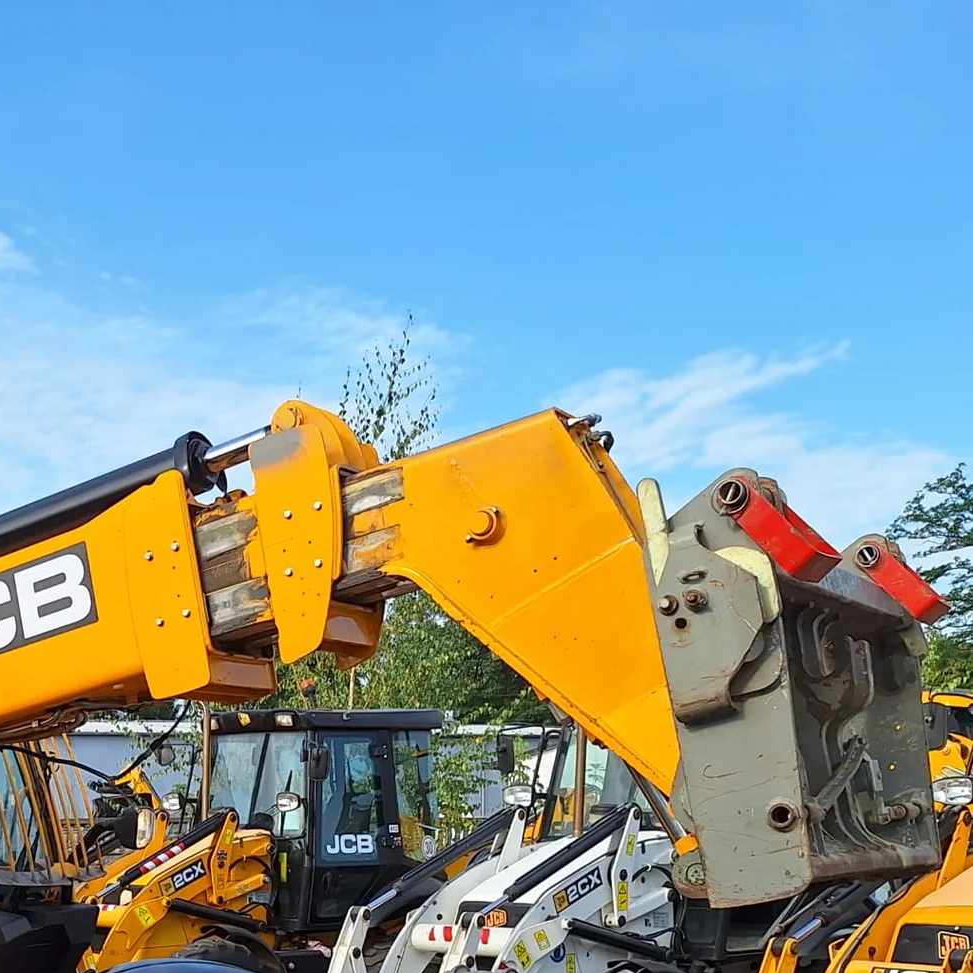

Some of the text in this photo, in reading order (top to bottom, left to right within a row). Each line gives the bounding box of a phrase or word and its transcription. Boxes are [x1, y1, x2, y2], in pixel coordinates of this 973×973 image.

[326, 834, 374, 854] JCB
[173, 861, 205, 889] 2CX
[567, 868, 603, 903] 2CX
[486, 911, 505, 927] JCB
